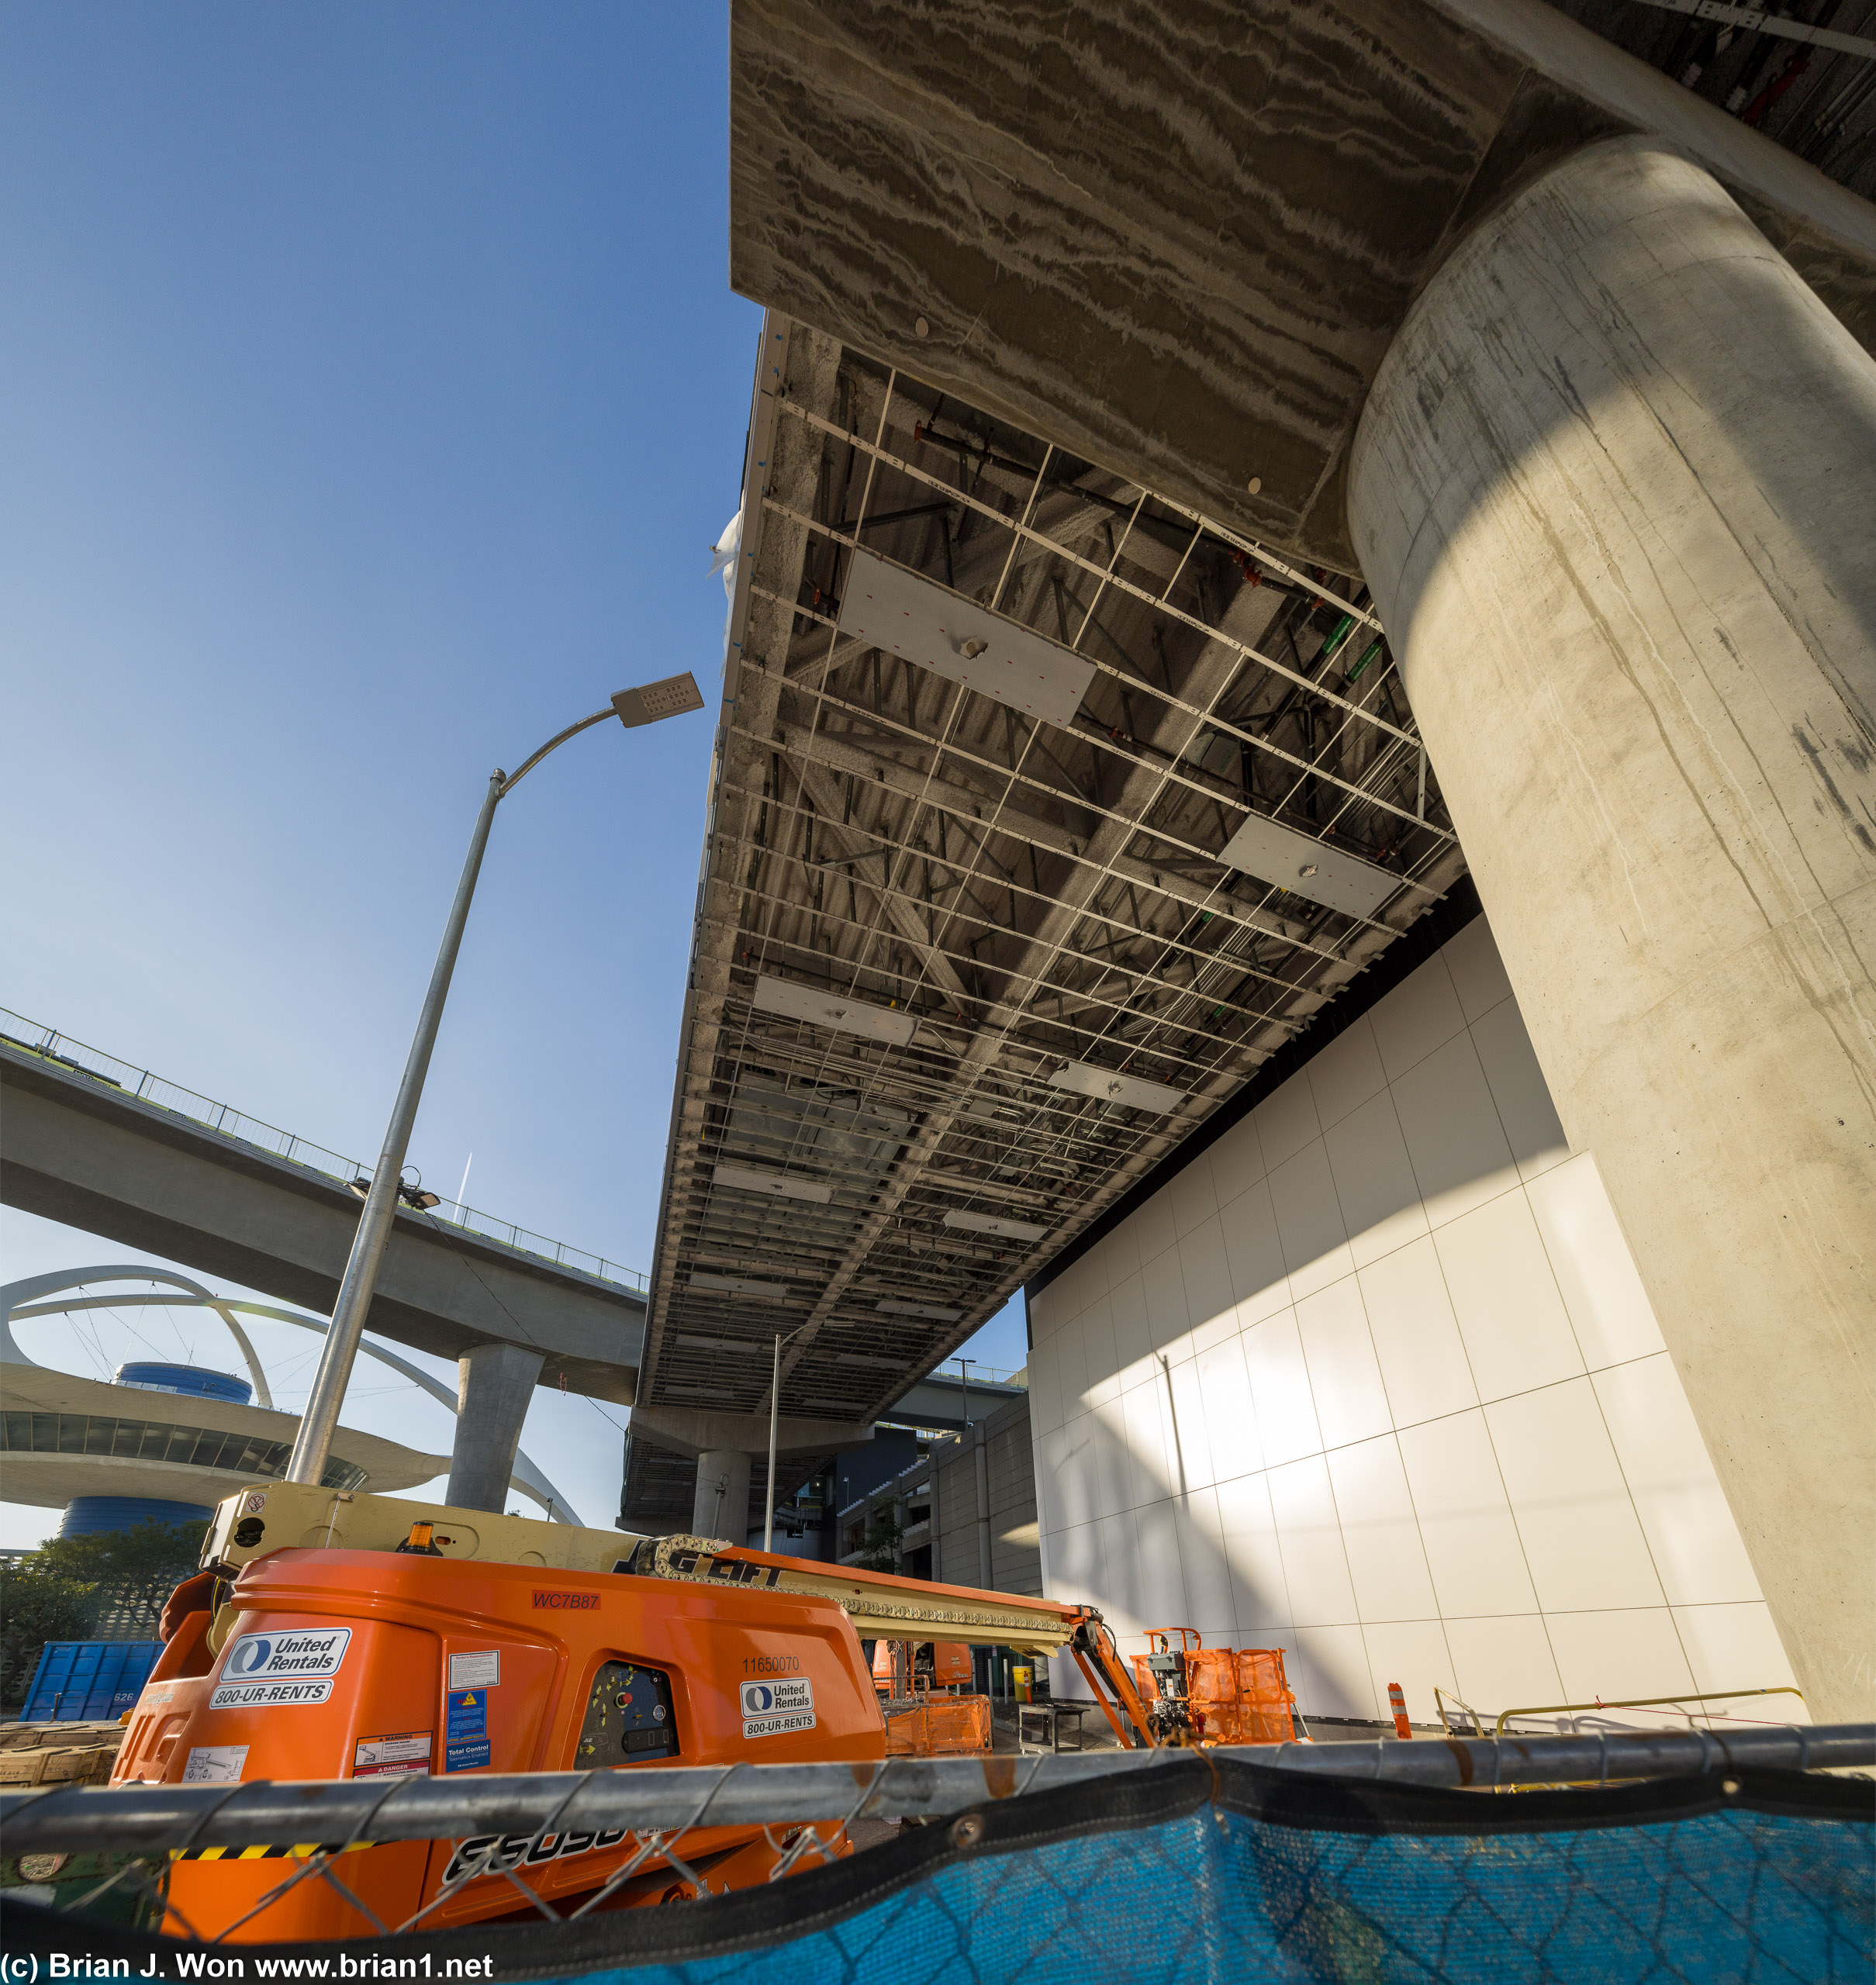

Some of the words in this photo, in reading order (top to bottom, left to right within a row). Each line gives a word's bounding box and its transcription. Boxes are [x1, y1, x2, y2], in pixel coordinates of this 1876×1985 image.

[533, 1593, 599, 1610] WC7B87
[275, 1636, 337, 1654] United
[266, 1653, 334, 1671] Rentals
[742, 1656, 800, 1673] 11650070
[114, 1693, 133, 1701] 626
[215, 1684, 326, 1704] 800-UR-RENTS
[773, 1683, 805, 1697] United
[775, 1694, 810, 1709] Rentals
[747, 1715, 814, 1735] 800-UR-RENTS
[465, 1745, 489, 1753] Control
[448, 1754, 471, 1762] Telematics
